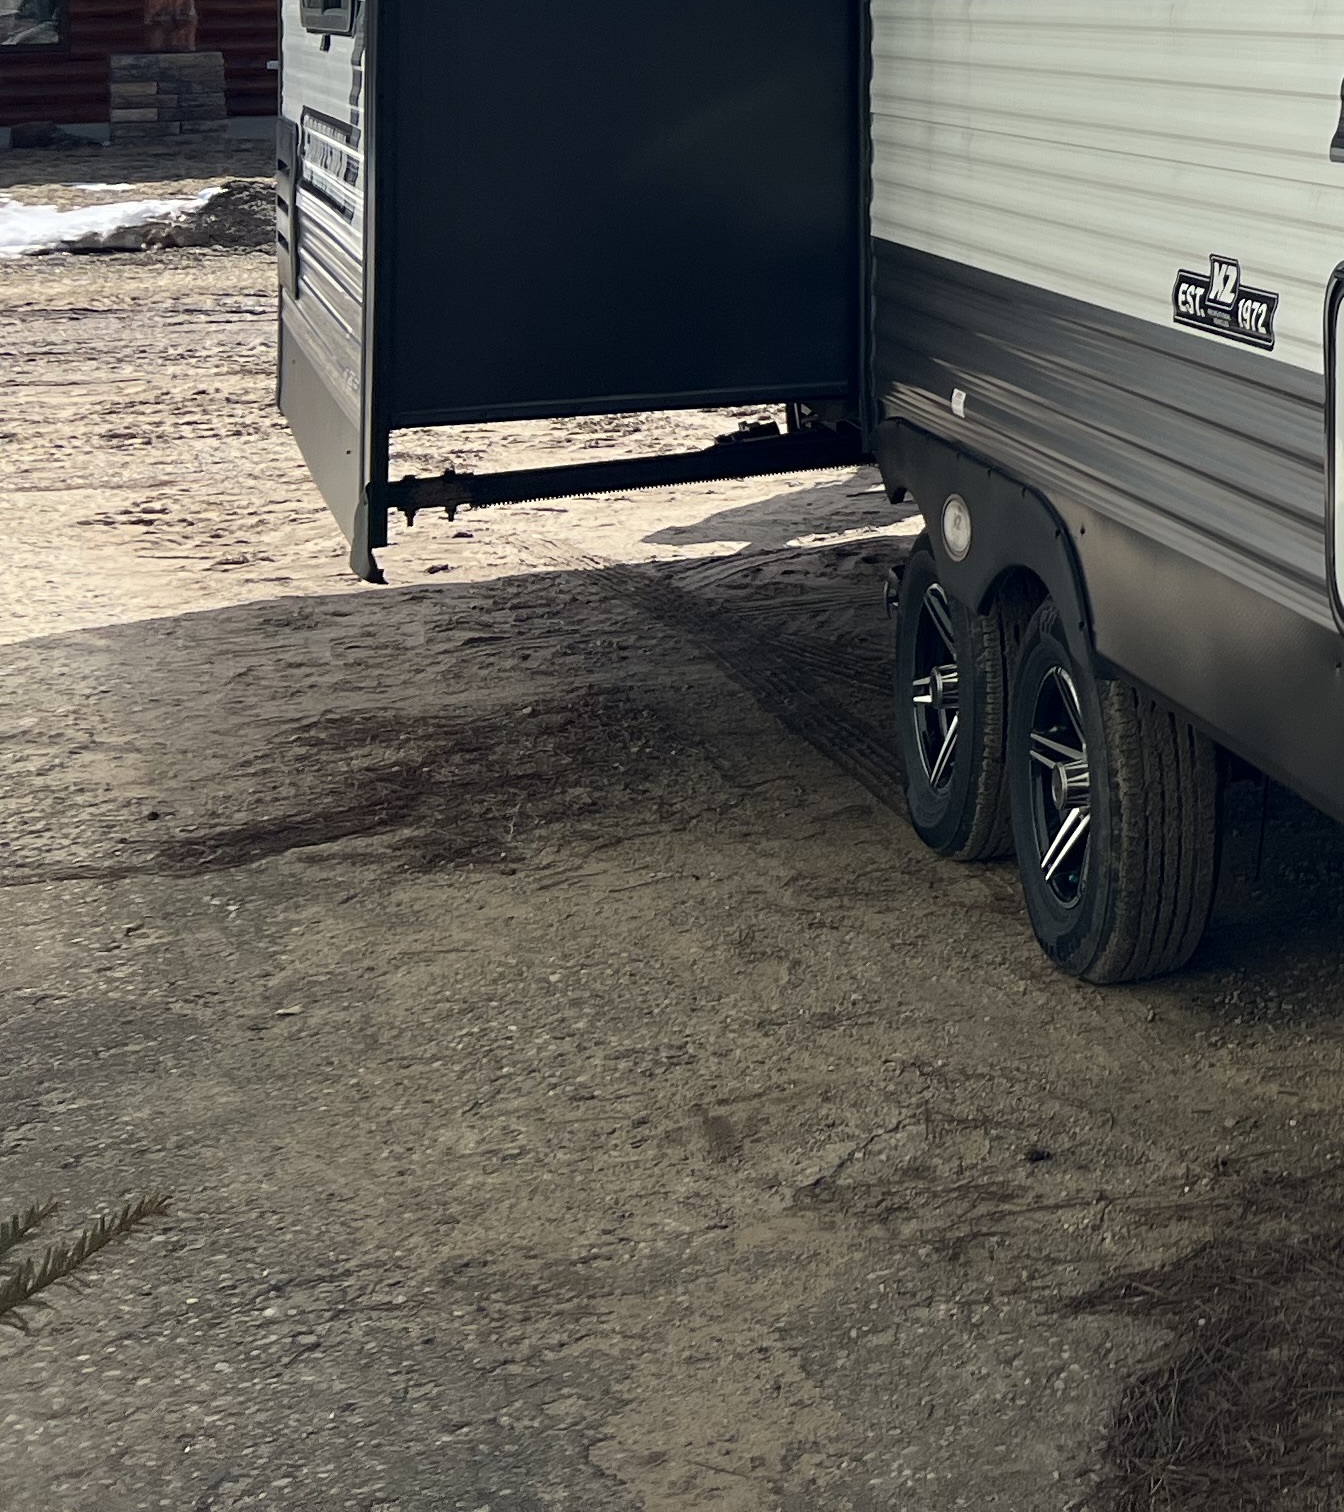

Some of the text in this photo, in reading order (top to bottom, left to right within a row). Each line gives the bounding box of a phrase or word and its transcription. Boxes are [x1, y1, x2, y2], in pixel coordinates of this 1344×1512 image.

[1208, 261, 1238, 304] KZ
[1178, 282, 1268, 334] EST. 1972
